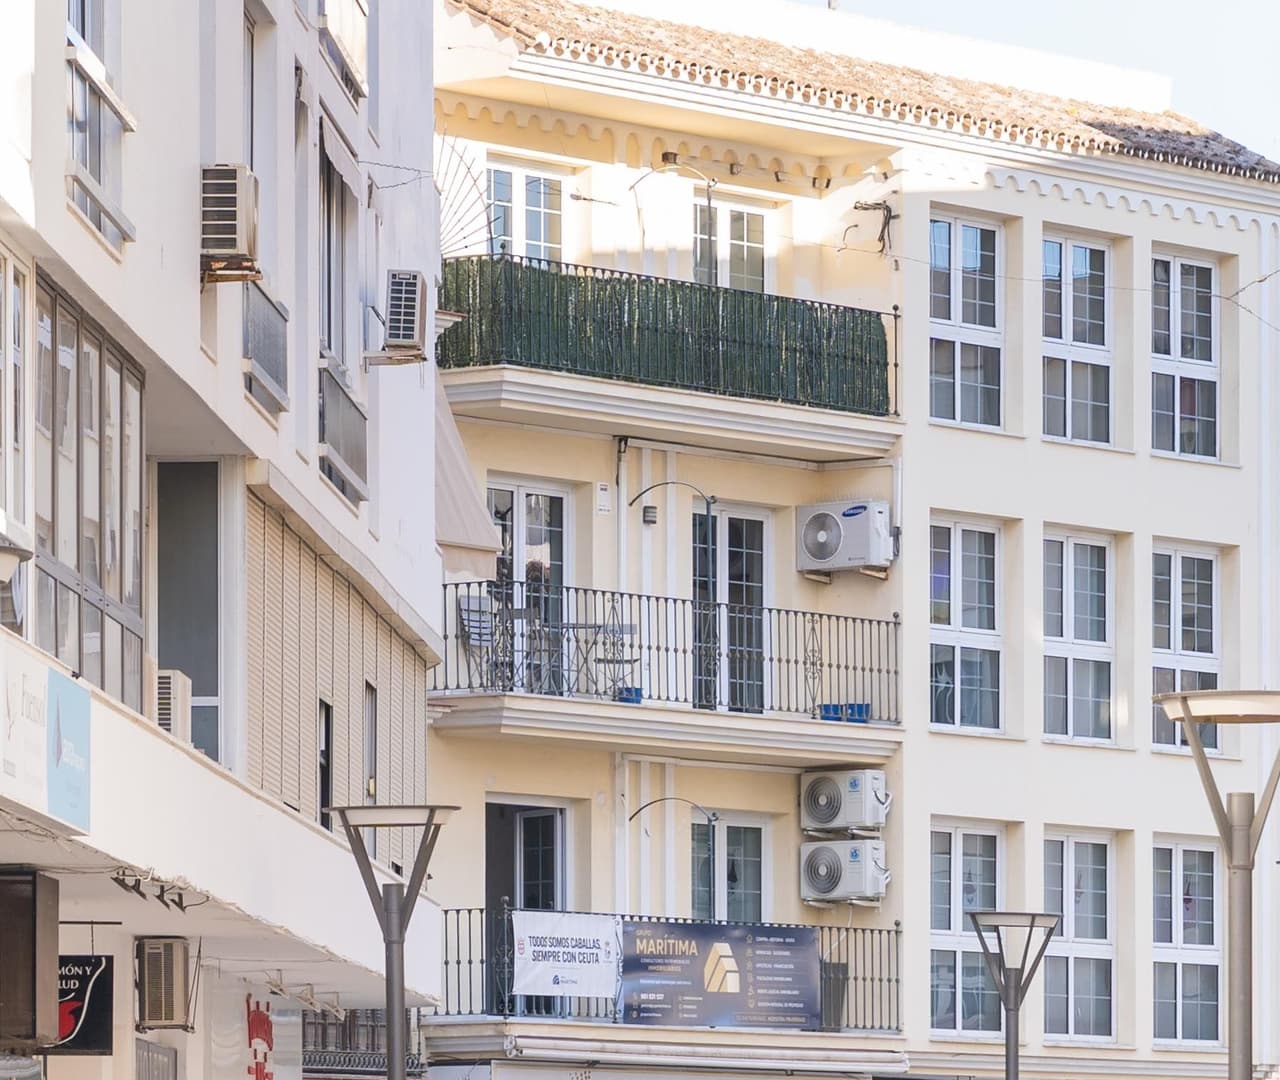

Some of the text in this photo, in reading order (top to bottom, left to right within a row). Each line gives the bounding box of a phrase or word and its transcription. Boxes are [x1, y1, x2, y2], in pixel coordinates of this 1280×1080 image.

[528, 935, 548, 947] TODOS
[548, 936, 570, 948] SOMOS
[636, 934, 698, 956] MARÍTIMA
[532, 950, 599, 964] SIEMPRE CON CEUTA
[85, 966, 93, 975] Y
